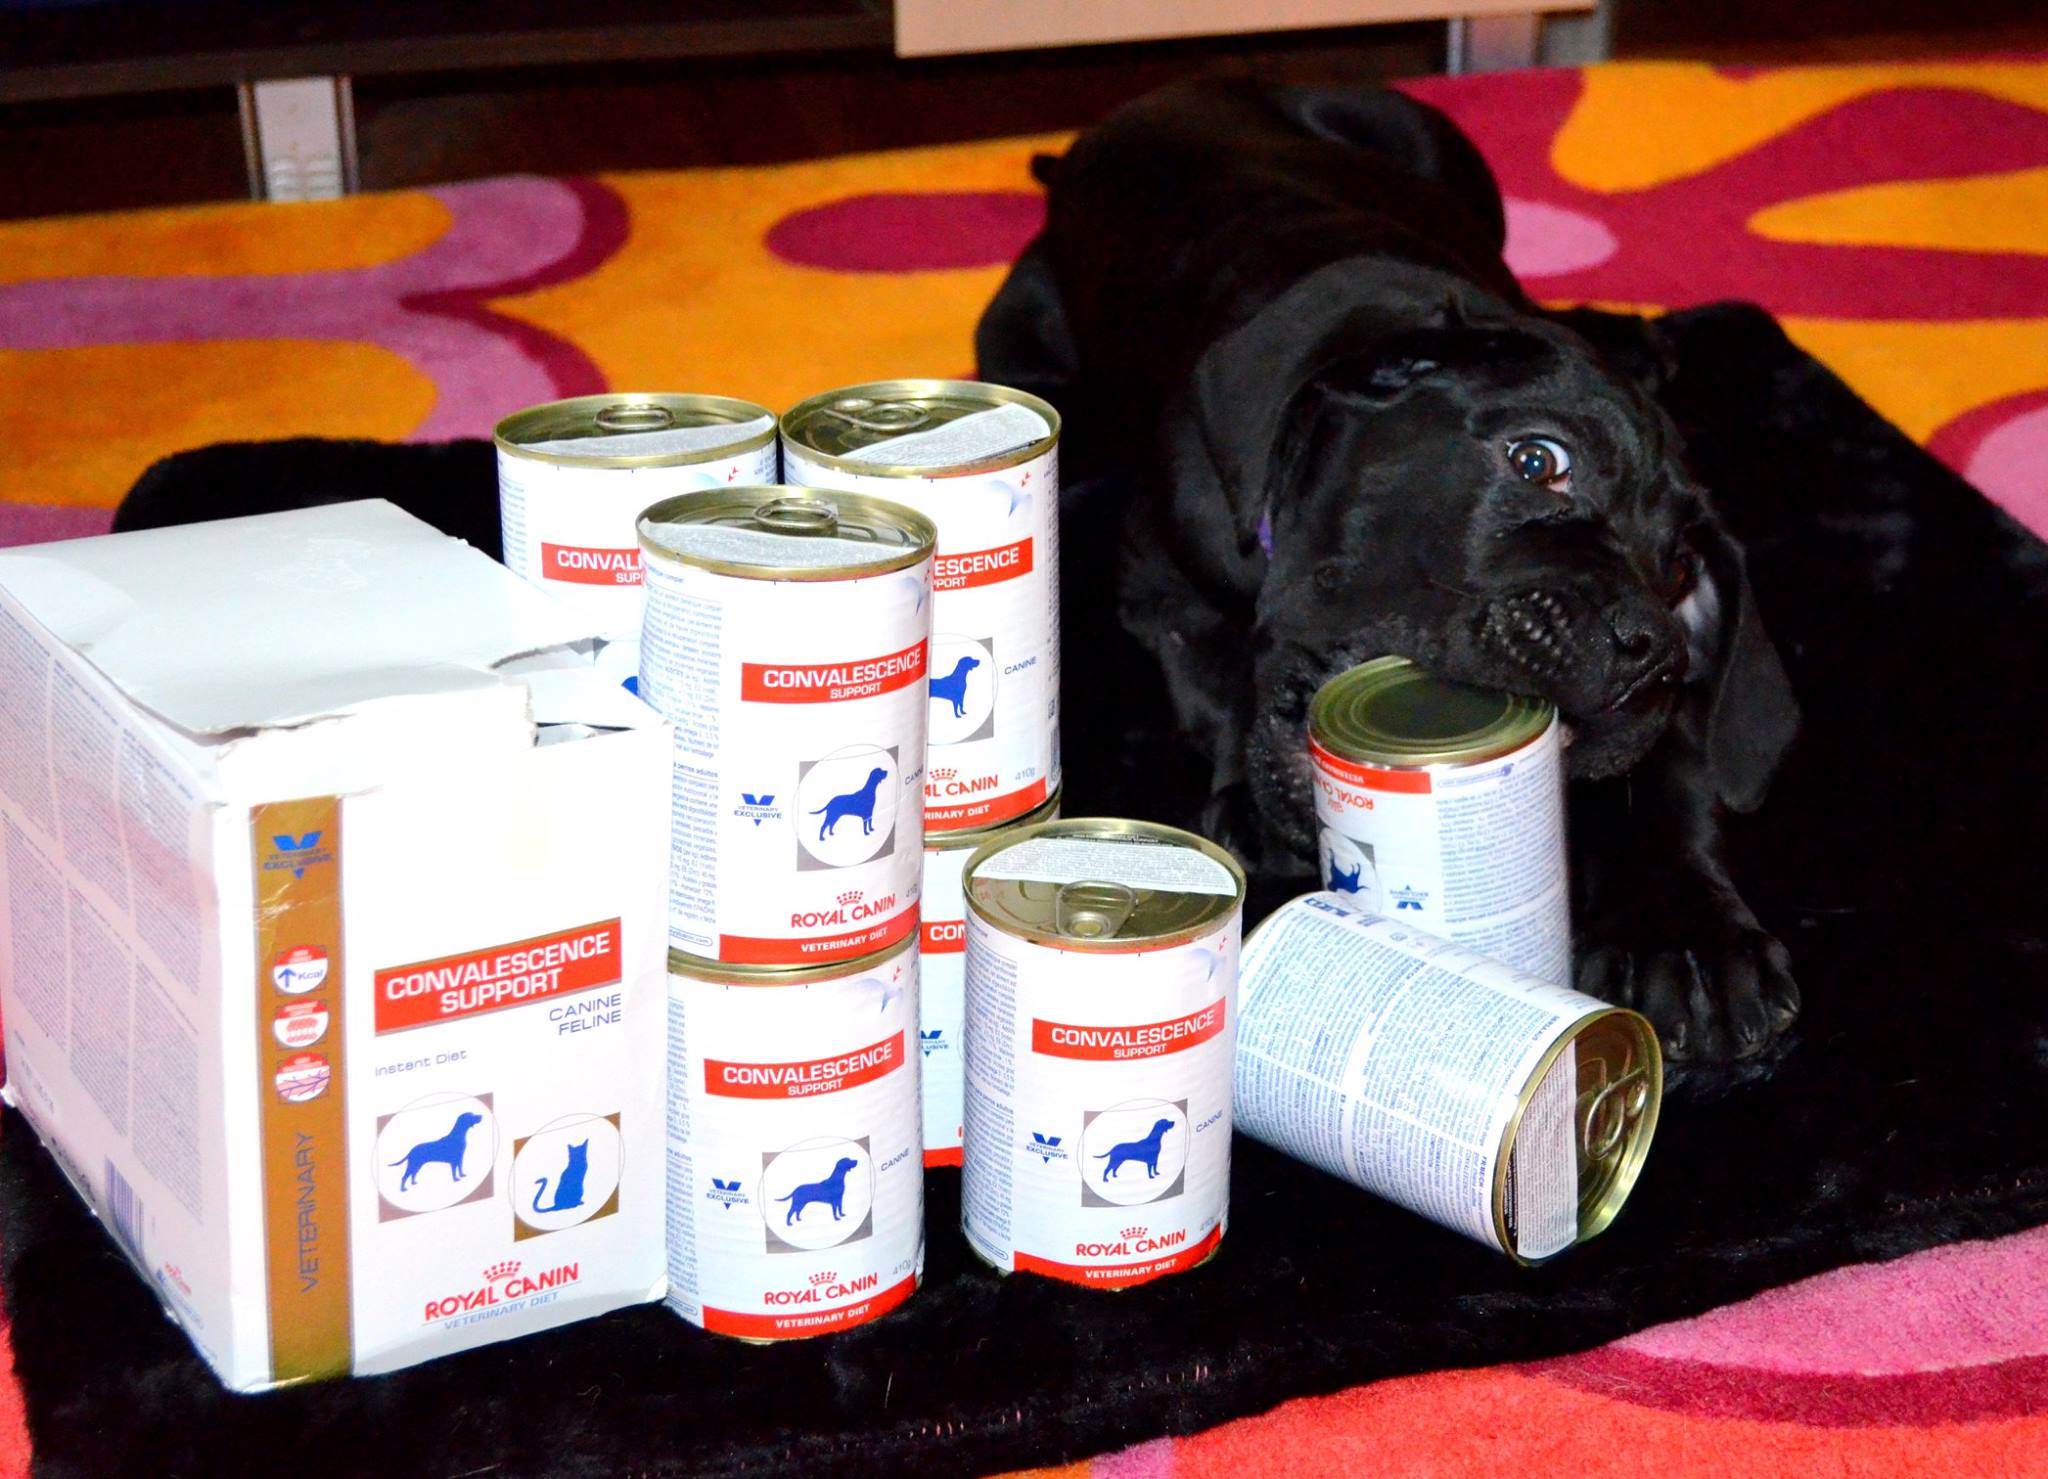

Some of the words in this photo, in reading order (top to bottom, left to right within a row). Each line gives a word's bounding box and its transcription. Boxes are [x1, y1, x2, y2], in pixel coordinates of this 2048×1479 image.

[763, 648, 921, 688] CONVALESCENCE
[1004, 656, 1037, 675] CANINE
[829, 682, 882, 700] SUPPORT
[946, 774, 999, 796] CANIN
[967, 804, 990, 817] DIET
[1335, 787, 1374, 811] ROYAL
[734, 810, 782, 820] EXCLUSIVE
[790, 908, 848, 929] ROYAL
[851, 892, 896, 921] CANIN
[801, 934, 868, 952] VETERINARY
[870, 926, 888, 941] DIET
[297, 968, 324, 980] Kcal
[386, 931, 611, 1000] CONVALESCENCE
[440, 967, 564, 1015] SUPPORT
[548, 992, 623, 1022] CANINE
[558, 1009, 623, 1036] FELINE
[1051, 1009, 1216, 1048] CONVALESCENCE
[374, 1056, 431, 1078] Instant
[435, 1049, 468, 1066] Diet
[723, 1041, 893, 1085] CONVALESCENCE
[1113, 1042, 1167, 1059] SUPPORT
[787, 1078, 844, 1097] SUPPORT
[879, 1147, 910, 1172] CANINE
[1026, 1145, 1069, 1160] EXCLUSIVE
[706, 1193, 750, 1205] EXCLUSIVE
[294, 1132, 320, 1293] VETERINARY
[1076, 1243, 1131, 1257] ROYAL
[1135, 1228, 1186, 1253] CANIN
[1085, 1265, 1153, 1279] VETERINARY
[1154, 1258, 1178, 1272] DIET
[425, 1286, 501, 1321] ROYAL
[504, 1262, 579, 1299] CANIN
[764, 1288, 822, 1306] ROYAL
[825, 1271, 879, 1300] CANIN
[444, 1301, 527, 1330] VETERINARY
[530, 1291, 560, 1308] DIET
[775, 1311, 846, 1329] VETERINARY
[848, 1303, 871, 1319] DIET
